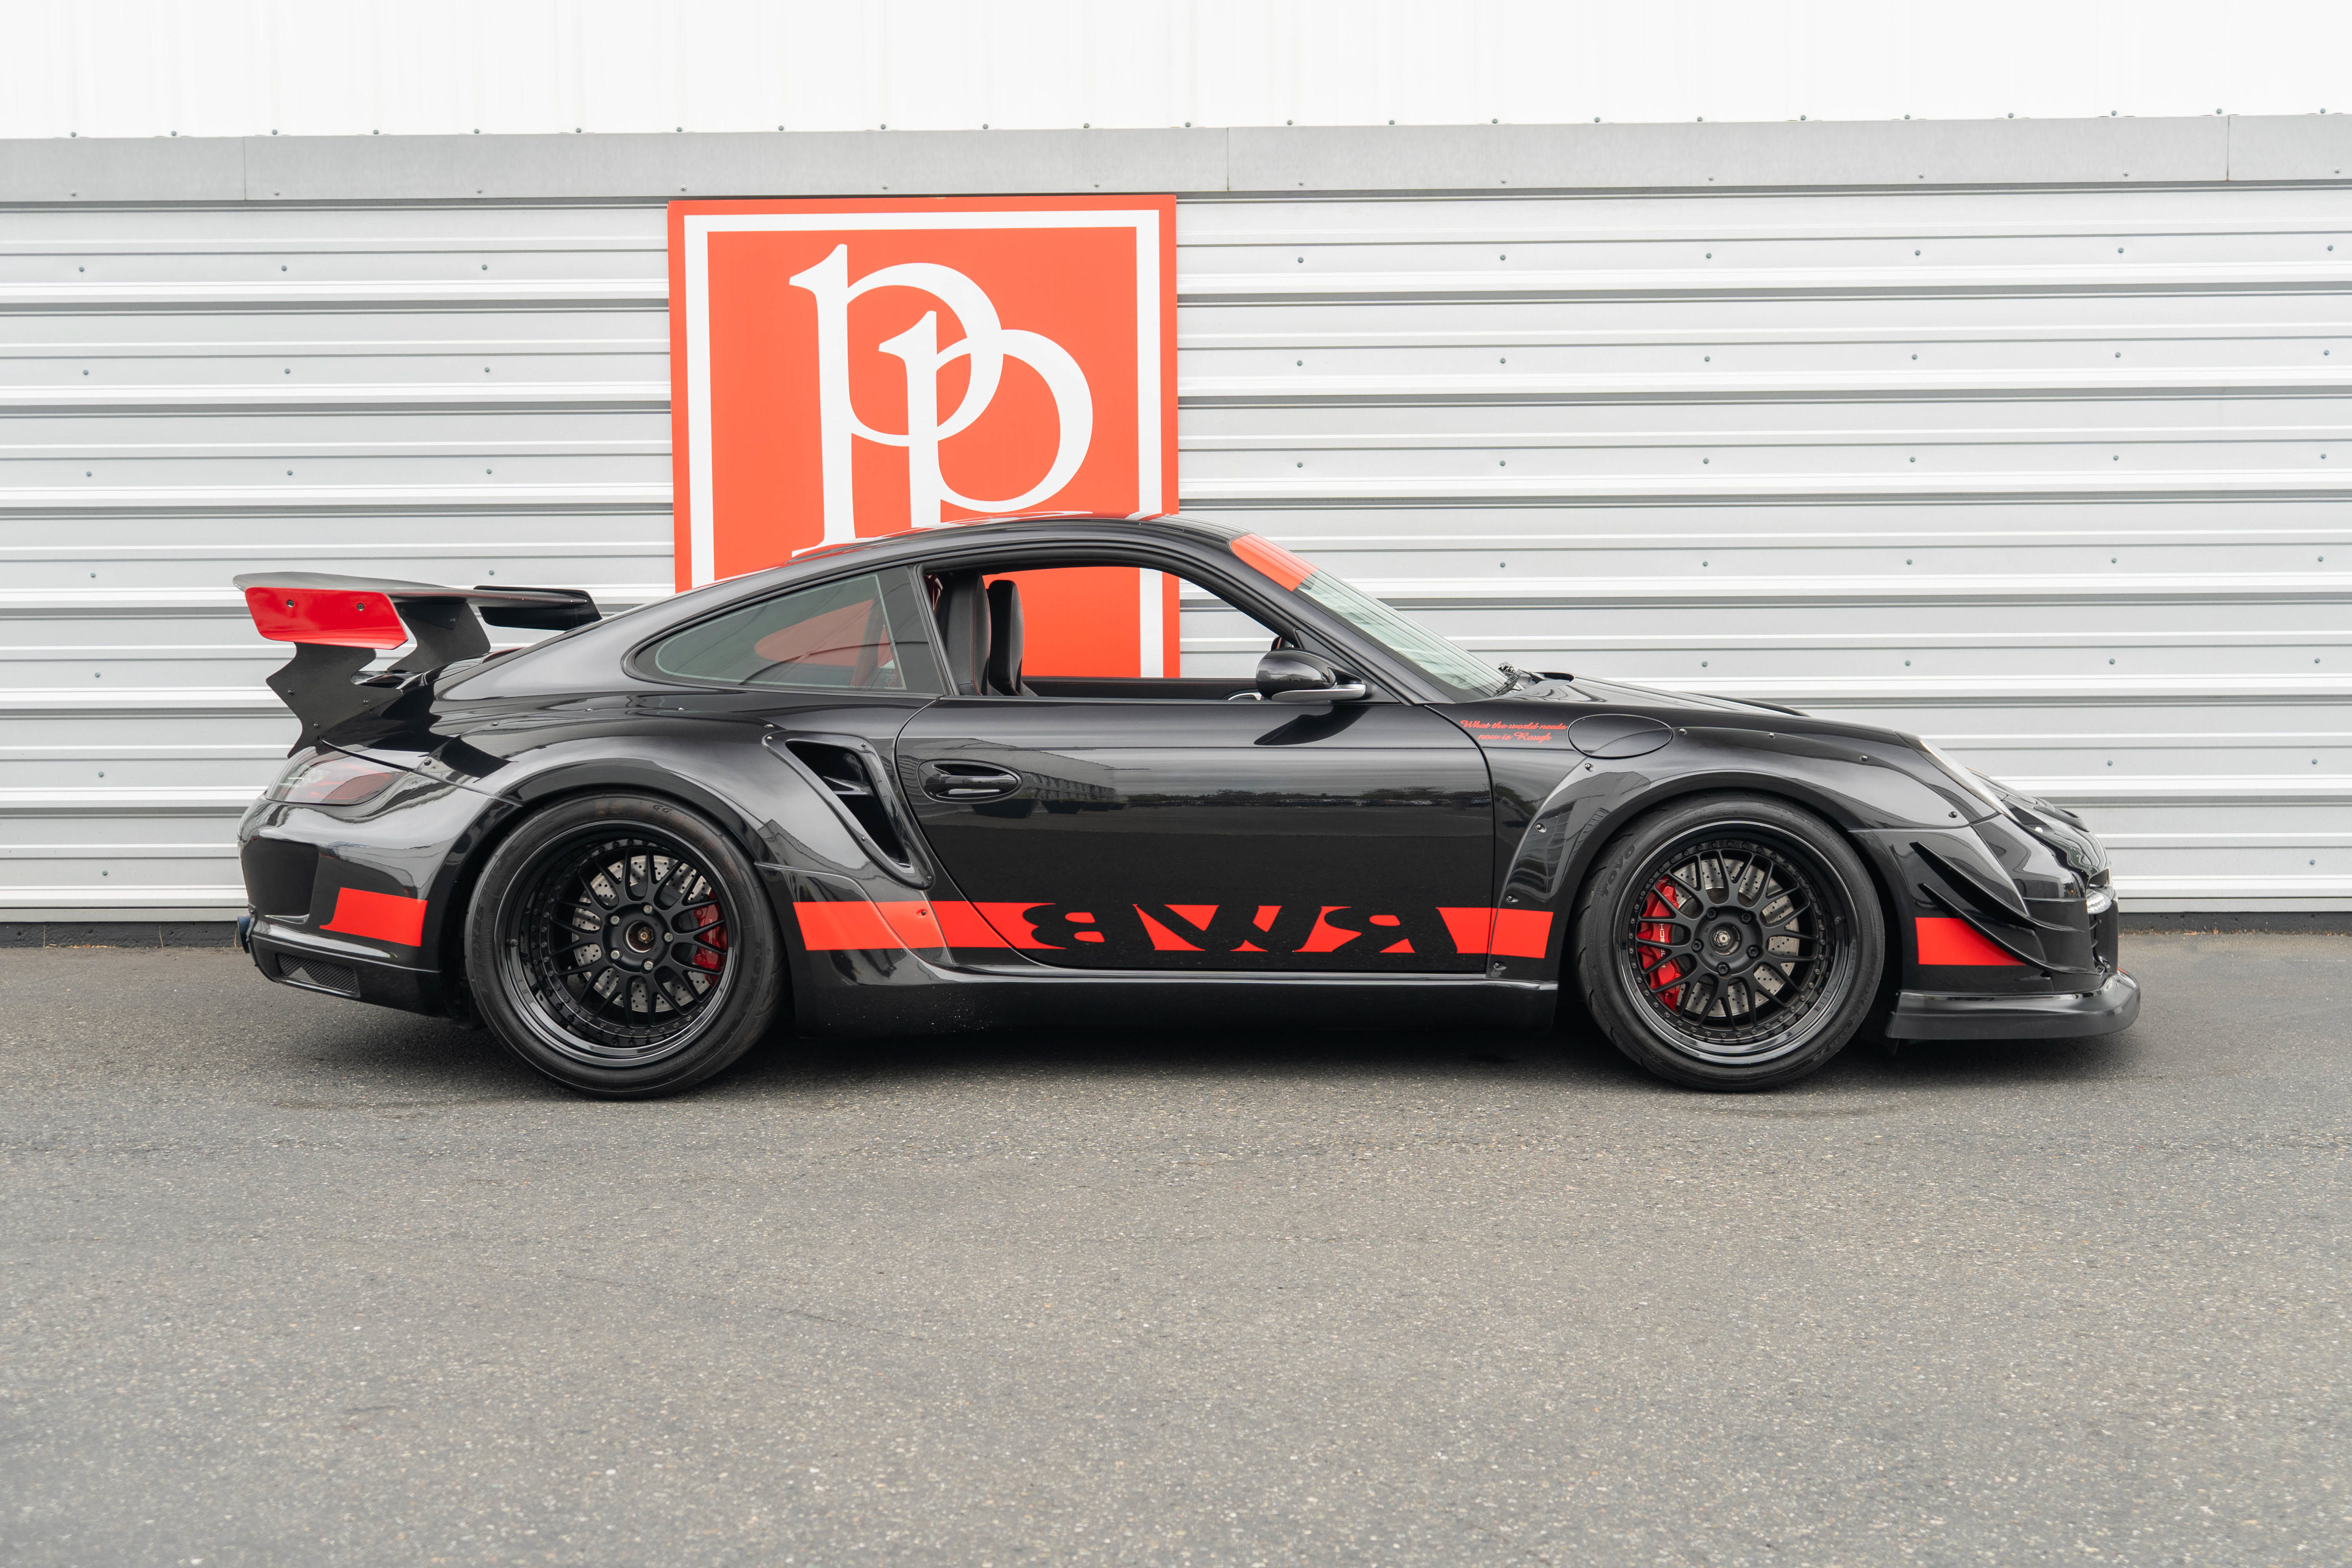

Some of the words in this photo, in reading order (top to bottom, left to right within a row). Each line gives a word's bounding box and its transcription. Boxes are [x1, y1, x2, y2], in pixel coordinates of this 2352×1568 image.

[1460, 720, 1490, 728] What
[1514, 732, 1552, 743] Rough
[1601, 845, 1635, 898] TOYO
